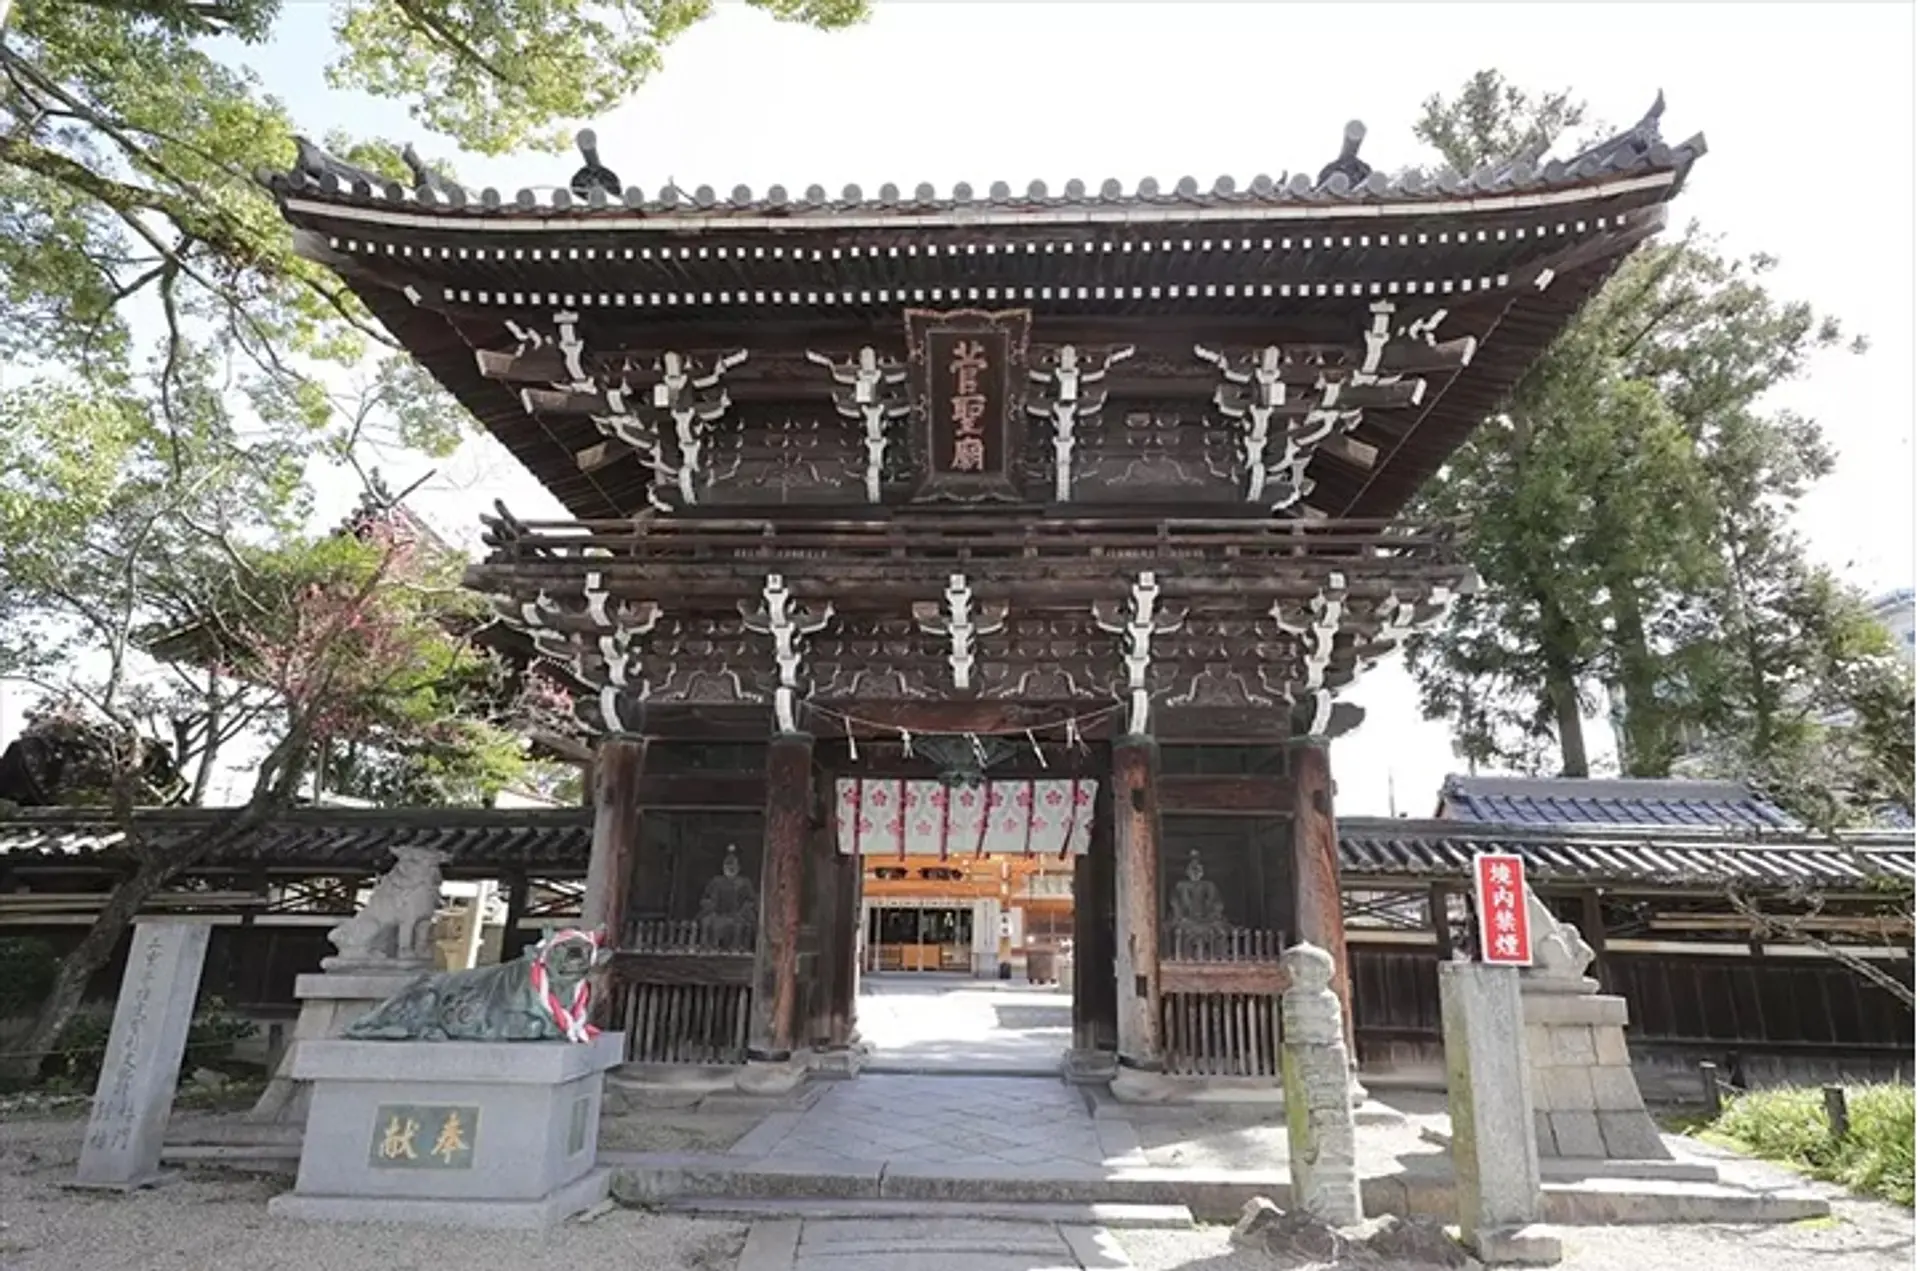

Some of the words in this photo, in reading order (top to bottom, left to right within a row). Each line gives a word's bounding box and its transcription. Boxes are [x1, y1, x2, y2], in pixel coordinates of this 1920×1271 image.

[949, 340, 988, 472] 菅聖廟
[1489, 862, 1520, 956] 境内禁煙
